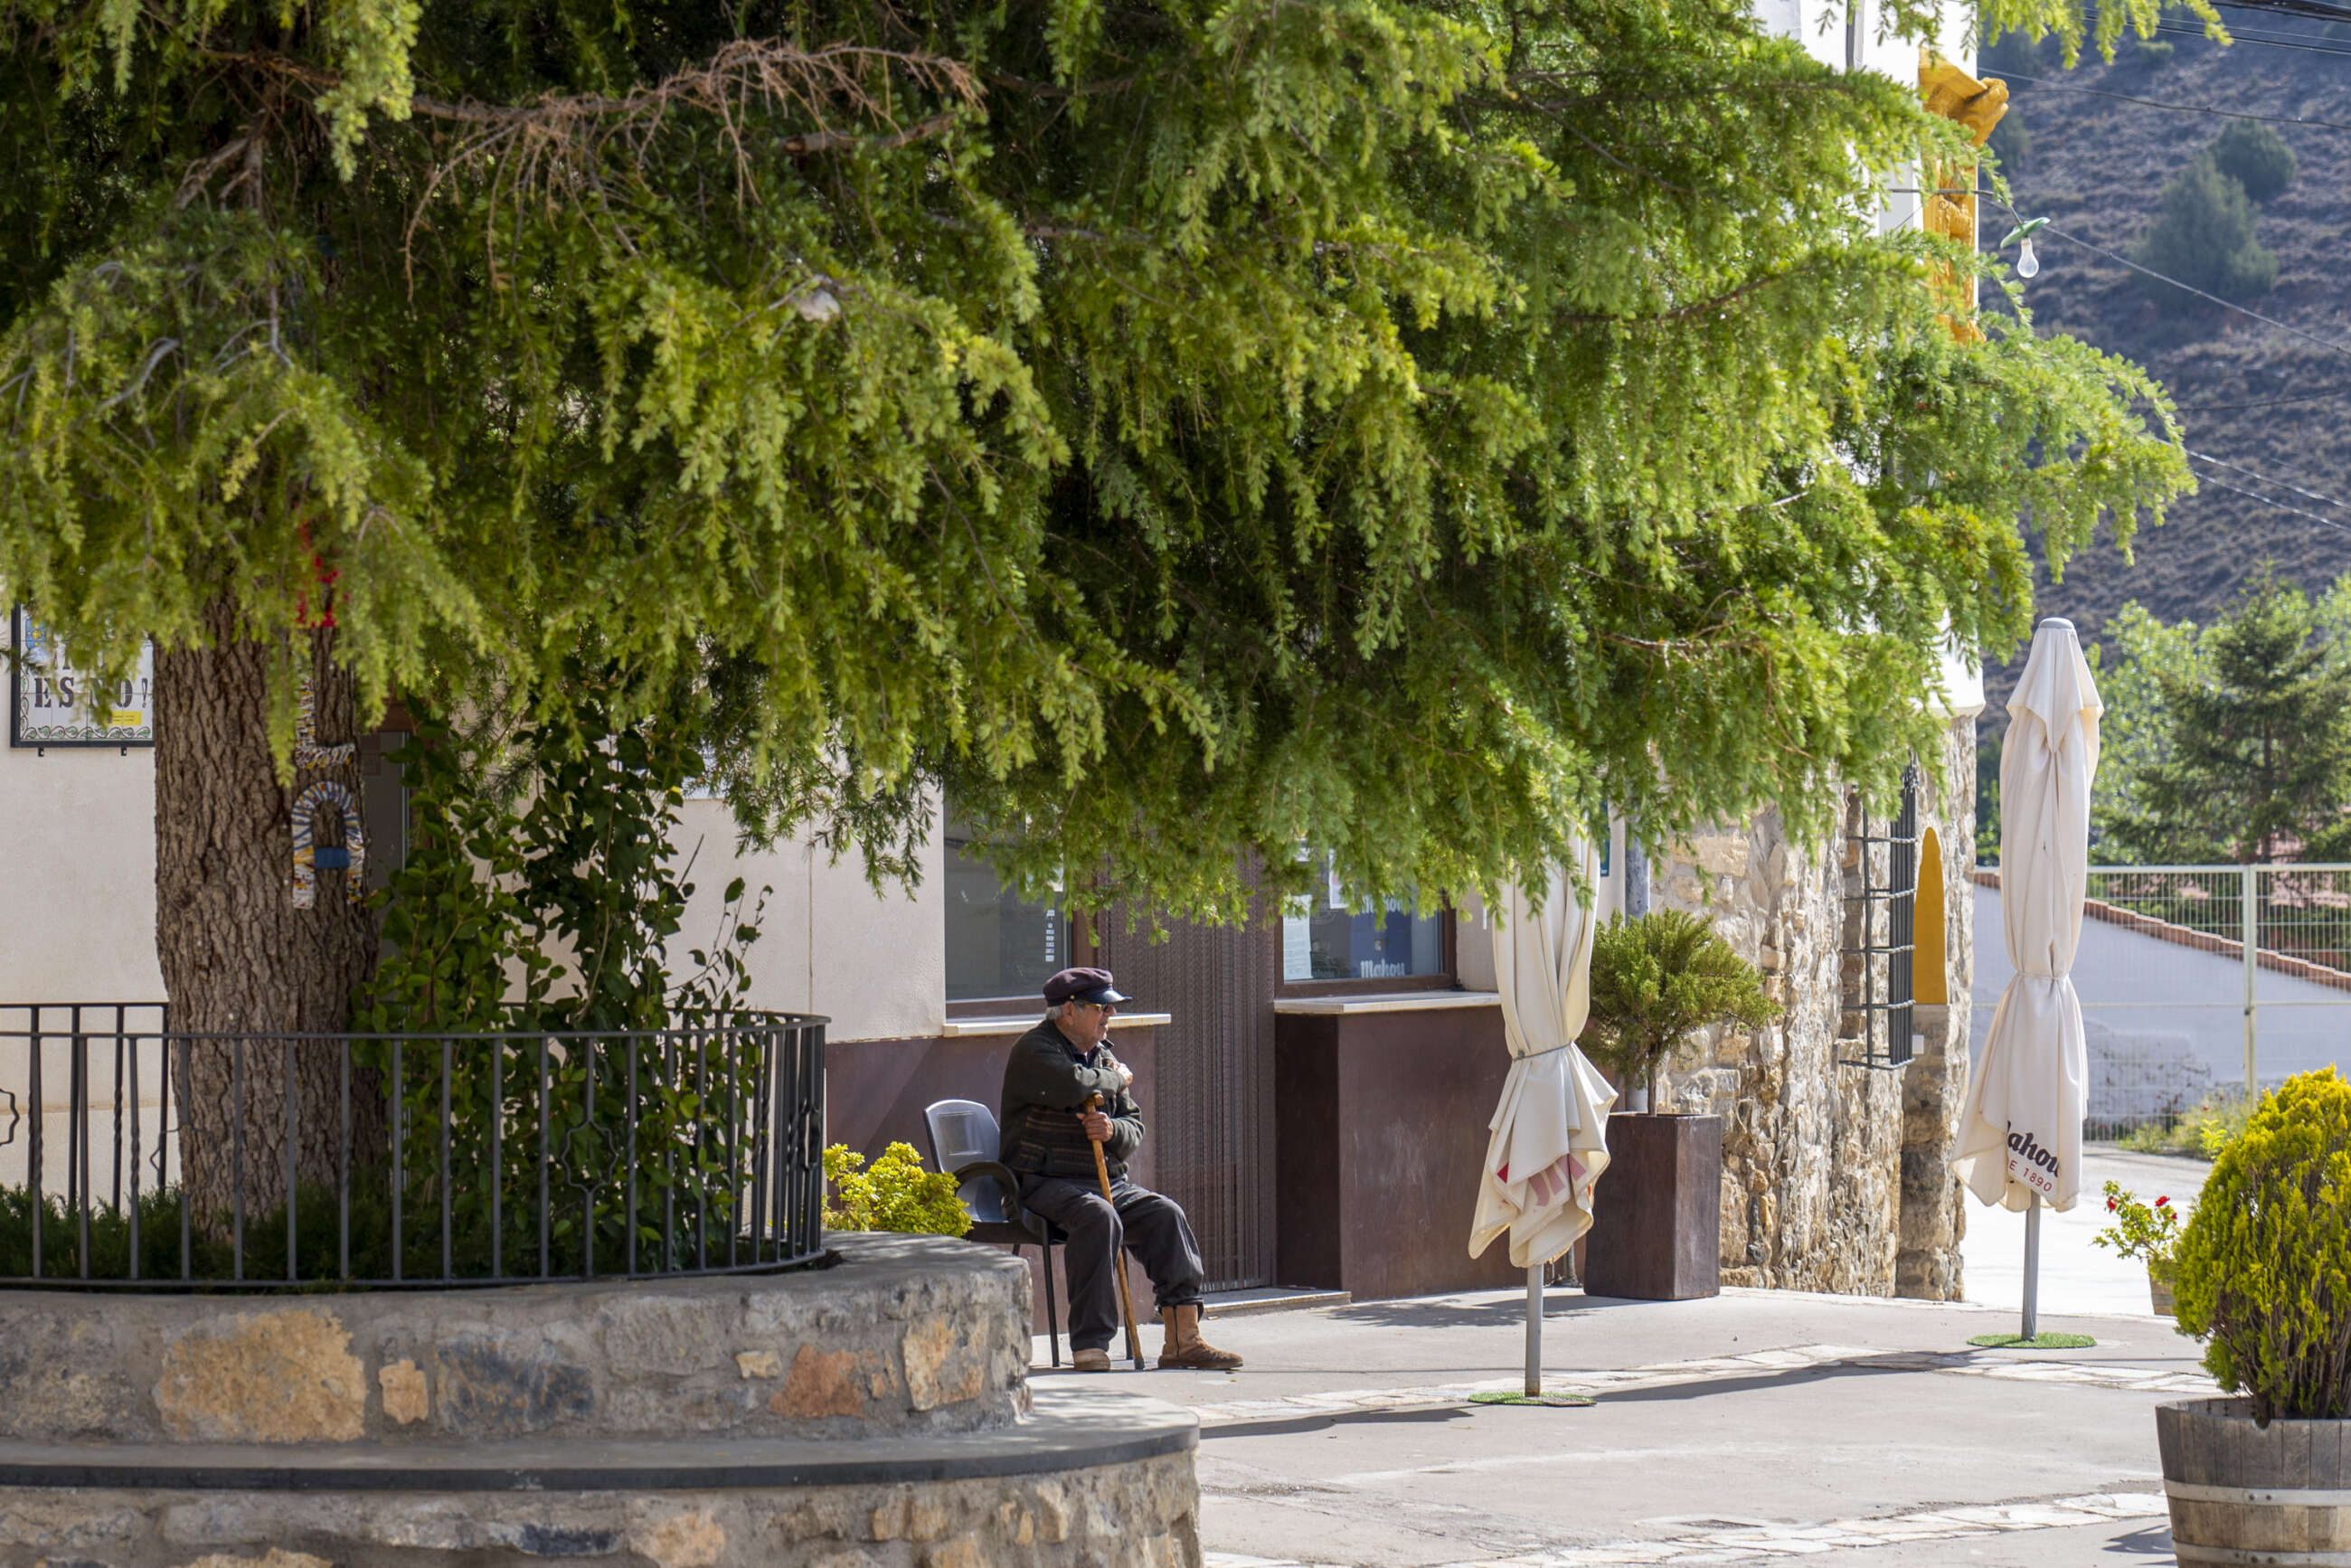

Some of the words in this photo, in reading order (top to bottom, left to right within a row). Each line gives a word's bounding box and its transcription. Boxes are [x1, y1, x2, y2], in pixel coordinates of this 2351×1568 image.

[33, 676, 75, 709] ES
[1360, 959, 1405, 978] Mahou
[2006, 1120, 2060, 1178] ahou
[2023, 1167, 2053, 1192] 1890
